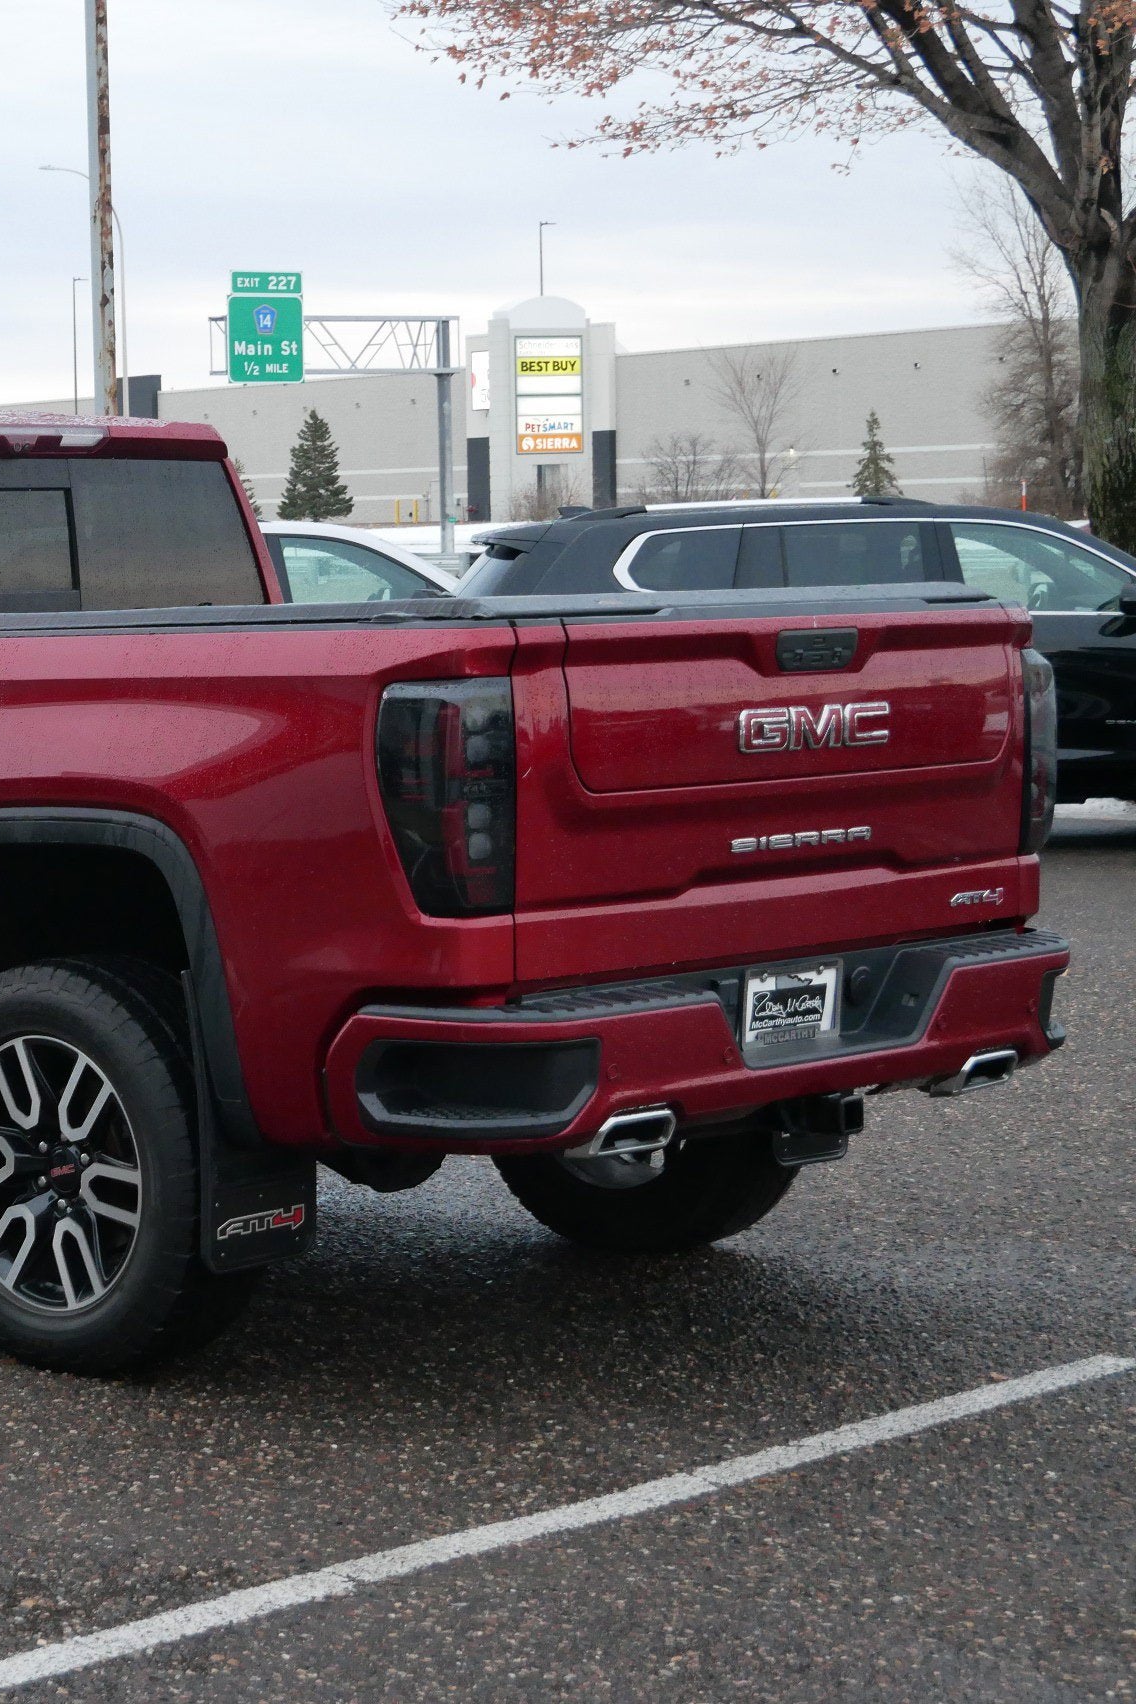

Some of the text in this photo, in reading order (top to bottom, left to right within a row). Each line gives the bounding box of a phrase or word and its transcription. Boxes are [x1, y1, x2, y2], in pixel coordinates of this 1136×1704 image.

[237, 276, 297, 290] EXIT 227
[259, 314, 272, 328] 14
[234, 341, 298, 356] Main St
[266, 363, 289, 373] MILE
[521, 360, 577, 372] BEST BUY
[535, 437, 579, 449] SIERRA
[738, 701, 890, 754] GMC
[730, 825, 872, 853] SIERRA
[950, 887, 1004, 907] AT4
[751, 1013, 821, 1030] McCarthyauto.com
[50, 1163, 75, 1177] GMC
[217, 1204, 304, 1240] AT4
